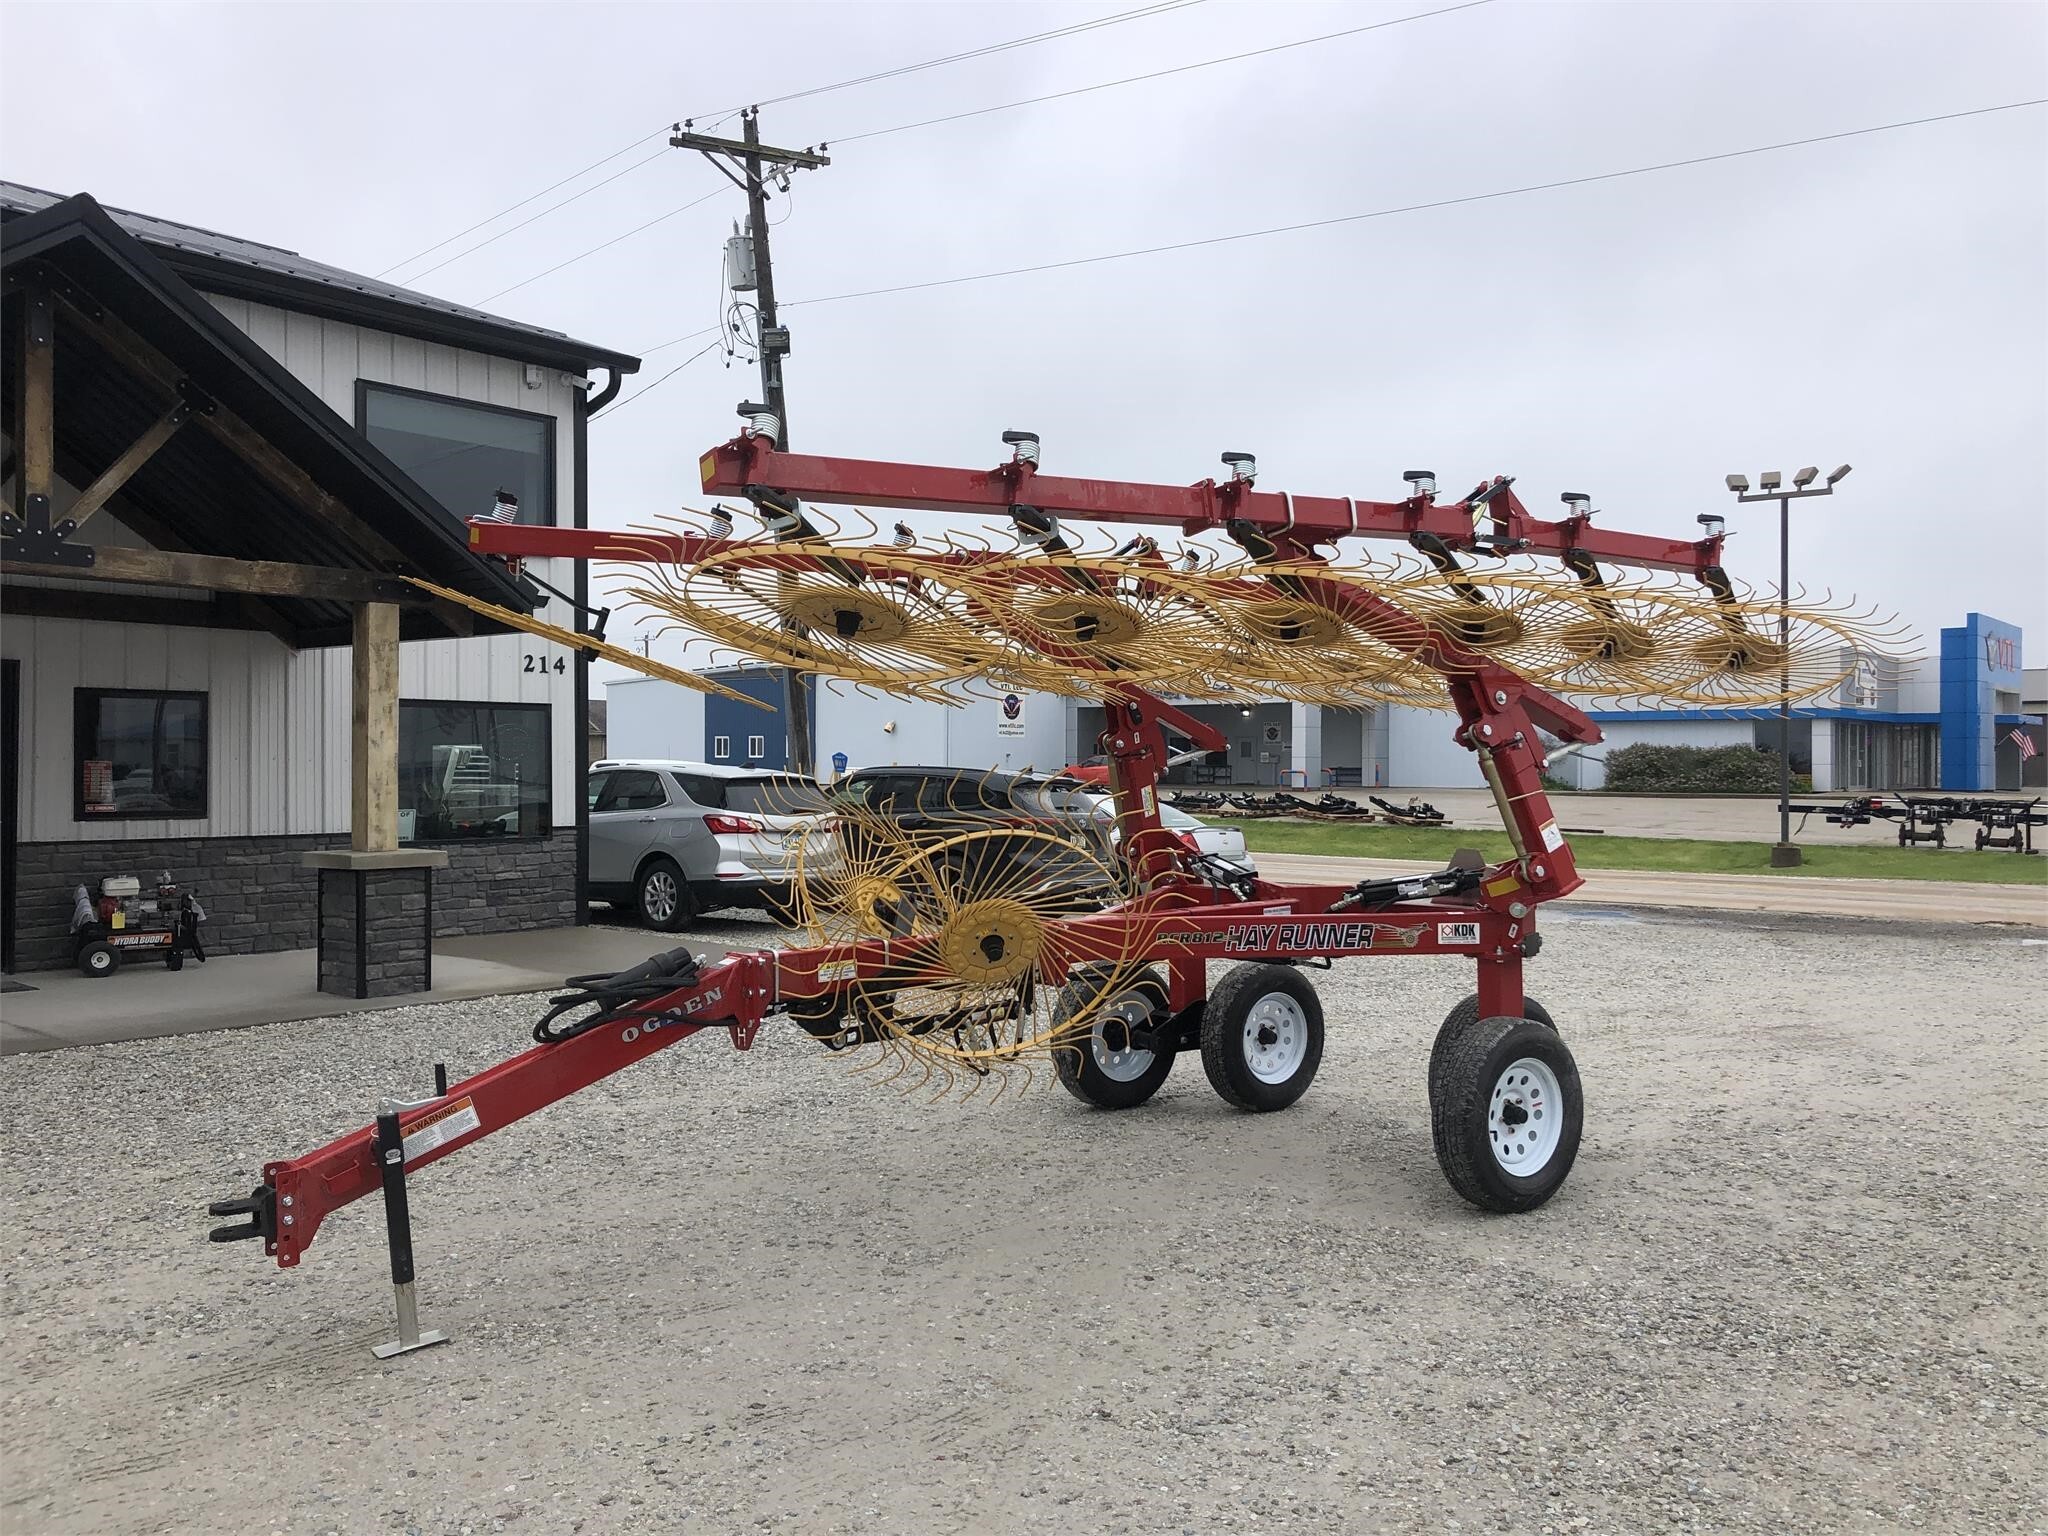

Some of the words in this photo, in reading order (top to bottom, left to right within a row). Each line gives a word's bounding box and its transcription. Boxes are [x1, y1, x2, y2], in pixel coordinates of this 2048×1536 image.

[523, 654, 566, 675] 214
[113, 937, 139, 946] HYDRA
[139, 935, 165, 944] BUDDY
[1224, 924, 1278, 951] HAY
[1276, 922, 1376, 951] RUNNER
[1454, 923, 1476, 937] KDK
[414, 1105, 458, 1129] WARNING
